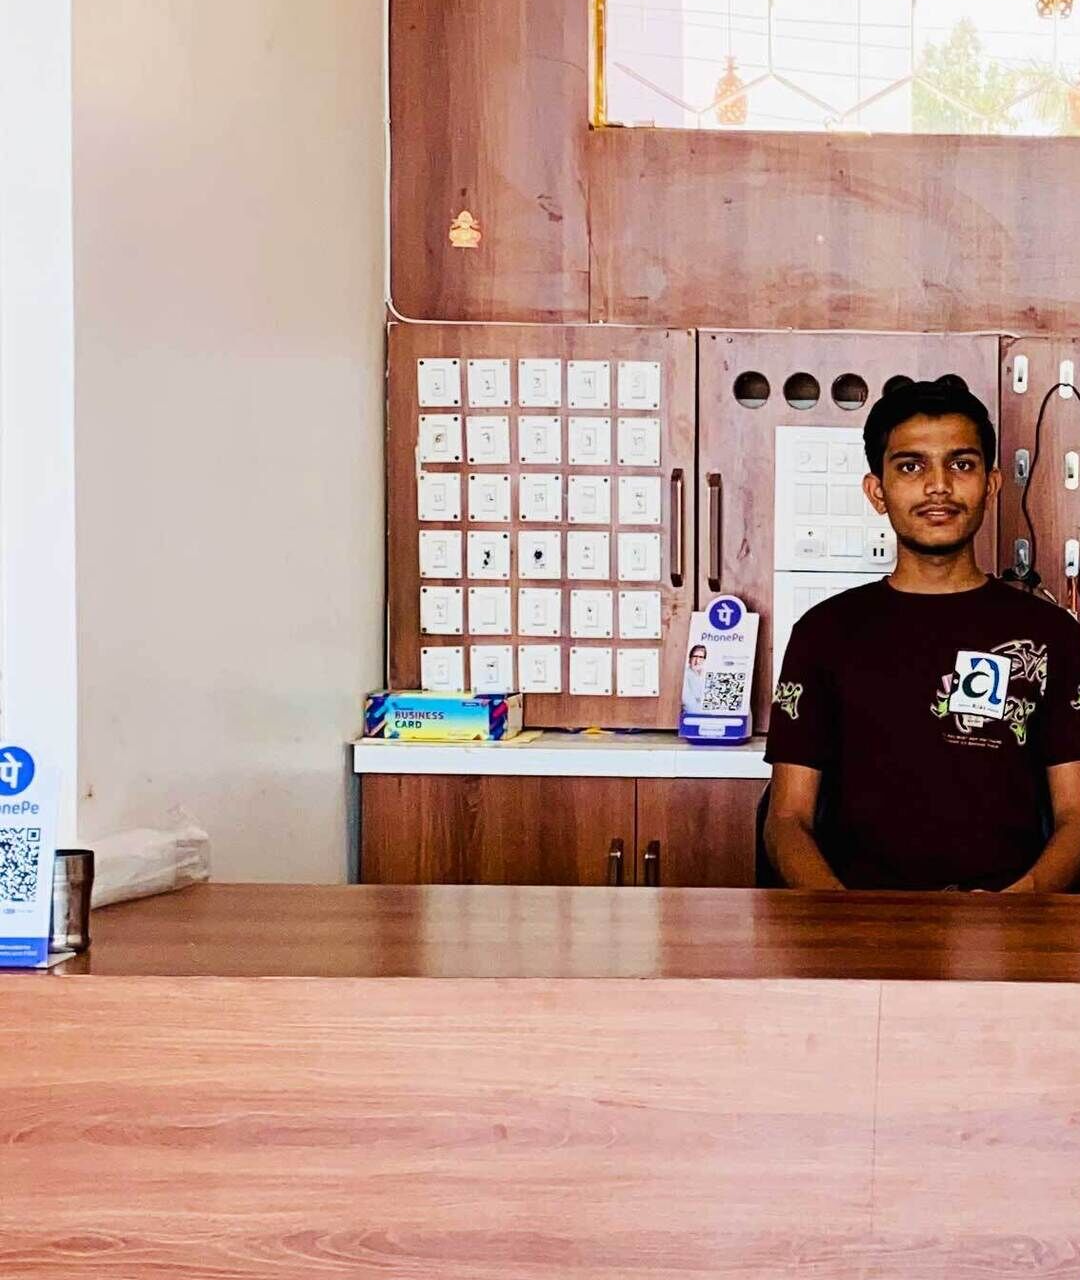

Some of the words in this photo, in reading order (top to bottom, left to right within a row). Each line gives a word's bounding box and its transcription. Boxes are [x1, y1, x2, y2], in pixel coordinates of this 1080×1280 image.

[700, 632, 745, 642] PhonePe
[394, 711, 445, 720] BUSINESS
[394, 720, 422, 729] CARD
[0, 800, 39, 815] nePe
